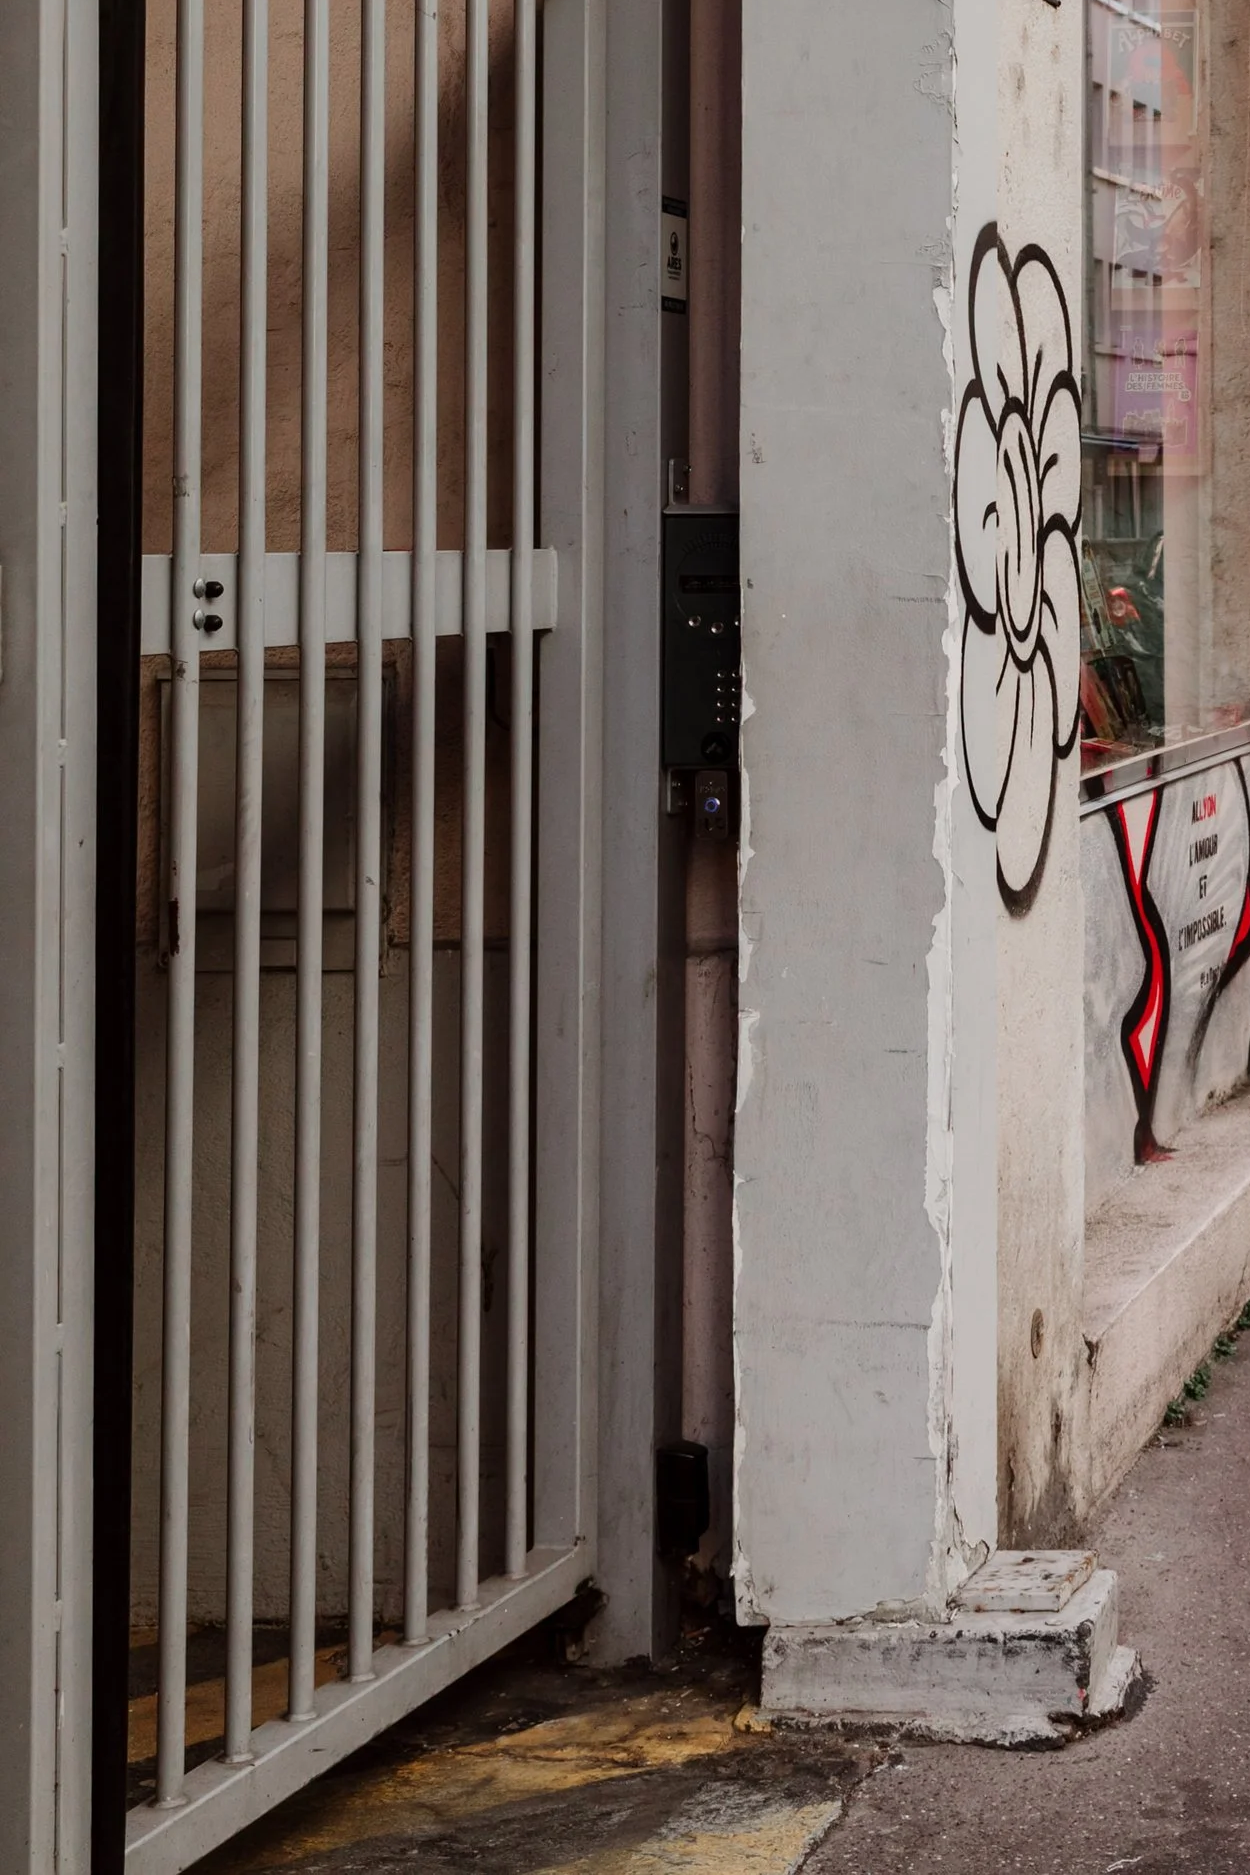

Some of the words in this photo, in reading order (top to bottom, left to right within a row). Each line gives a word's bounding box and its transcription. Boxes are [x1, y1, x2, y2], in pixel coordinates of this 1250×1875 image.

[1118, 28, 1190, 53] ALPBET
[1126, 382, 1143, 390] DES
[1146, 382, 1184, 390] FEMMES
[1189, 833, 1218, 867] L'AMOUR
[1199, 874, 1208, 899] ET
